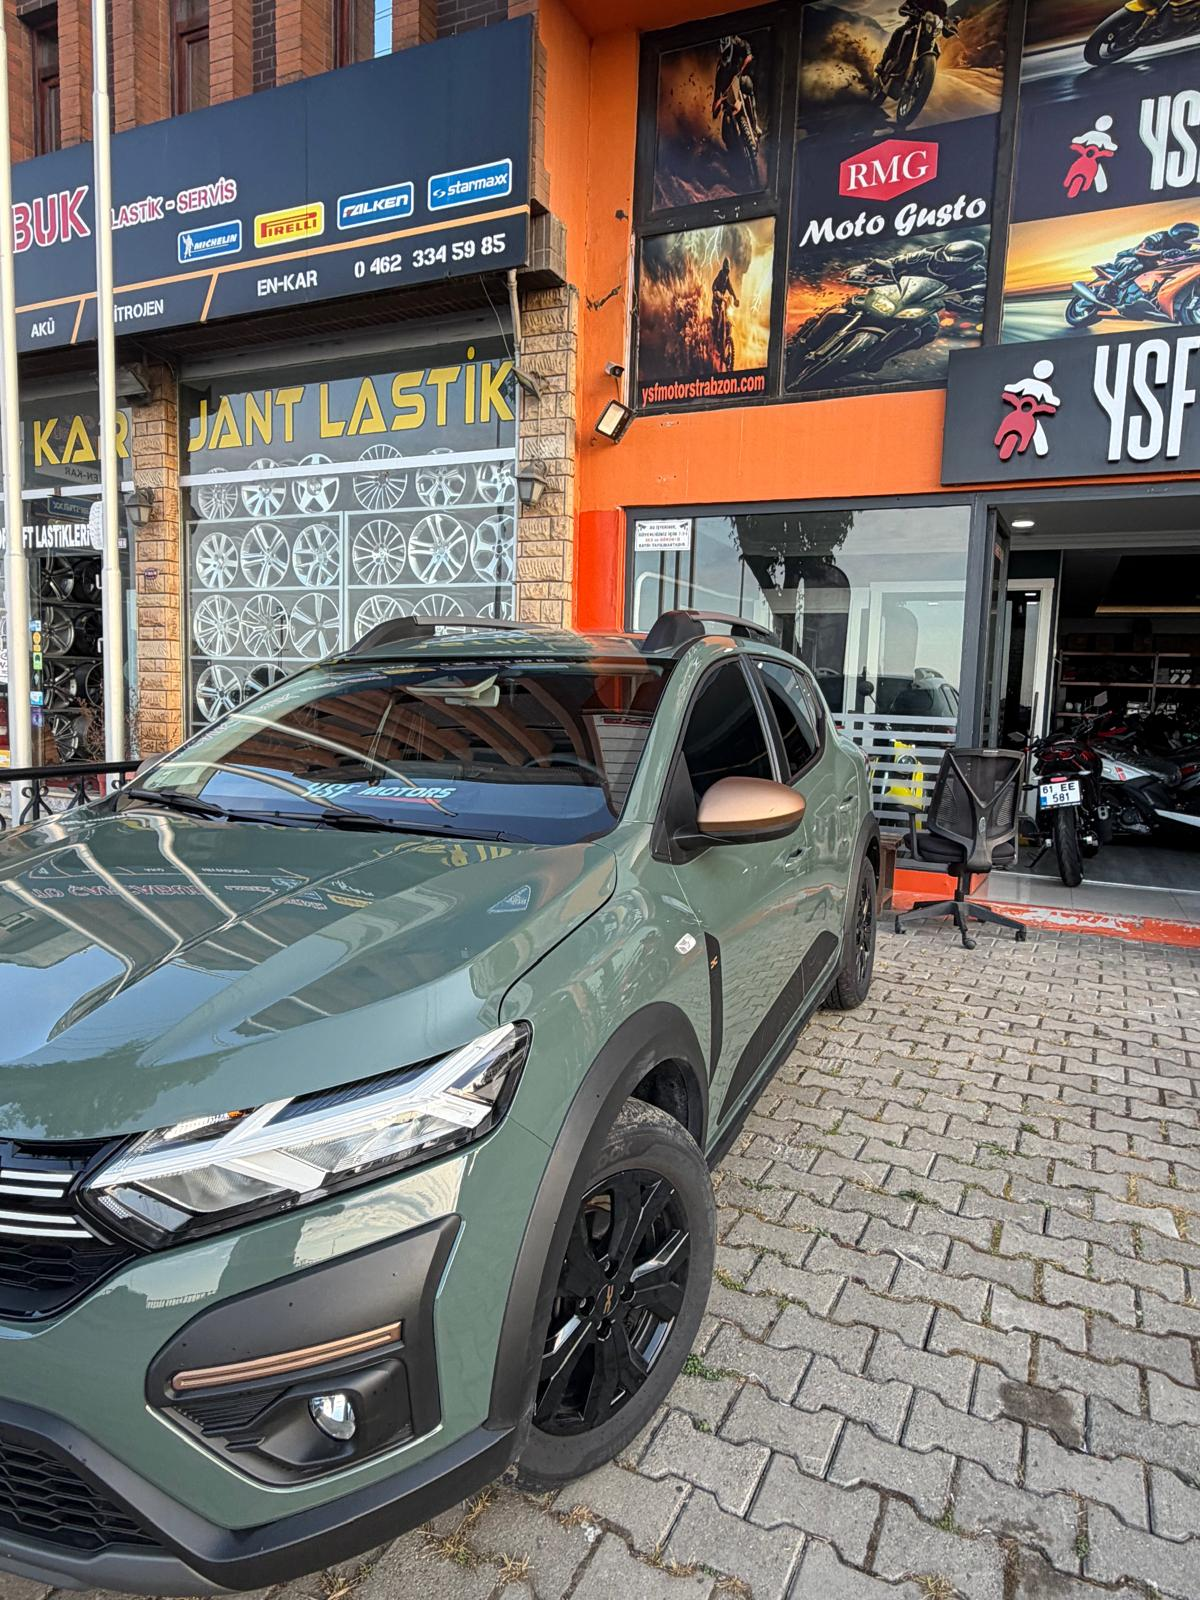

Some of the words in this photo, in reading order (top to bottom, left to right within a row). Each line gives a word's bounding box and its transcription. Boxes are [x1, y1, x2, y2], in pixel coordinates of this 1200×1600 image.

[1139, 88, 1200, 190] YS
[846, 149, 930, 192] RMG
[194, 233, 237, 250] MICHELIN
[260, 212, 317, 238] PIRELLI
[343, 194, 408, 218] FALKEN
[447, 172, 508, 196] starmaxx
[800, 214, 884, 248] Moto
[894, 194, 986, 237] Gusto
[354, 261, 365, 278] 0
[370, 254, 402, 276] 462
[412, 244, 447, 269] 334
[452, 240, 476, 262] 59
[481, 233, 506, 255] 85
[257, 270, 318, 297] EN-KAR
[112, 299, 164, 322] İTROJEN
[187, 386, 305, 453] JANT
[319, 346, 515, 440] LASTİK
[641, 374, 765, 407] ysfmotorstrabzon.com
[1093, 335, 1200, 461] YSF
[357, 786, 457, 799] MOTORS
[1042, 785, 1053, 794] 61
[1060, 782, 1076, 792] EE
[1052, 792, 1070, 803] 581
